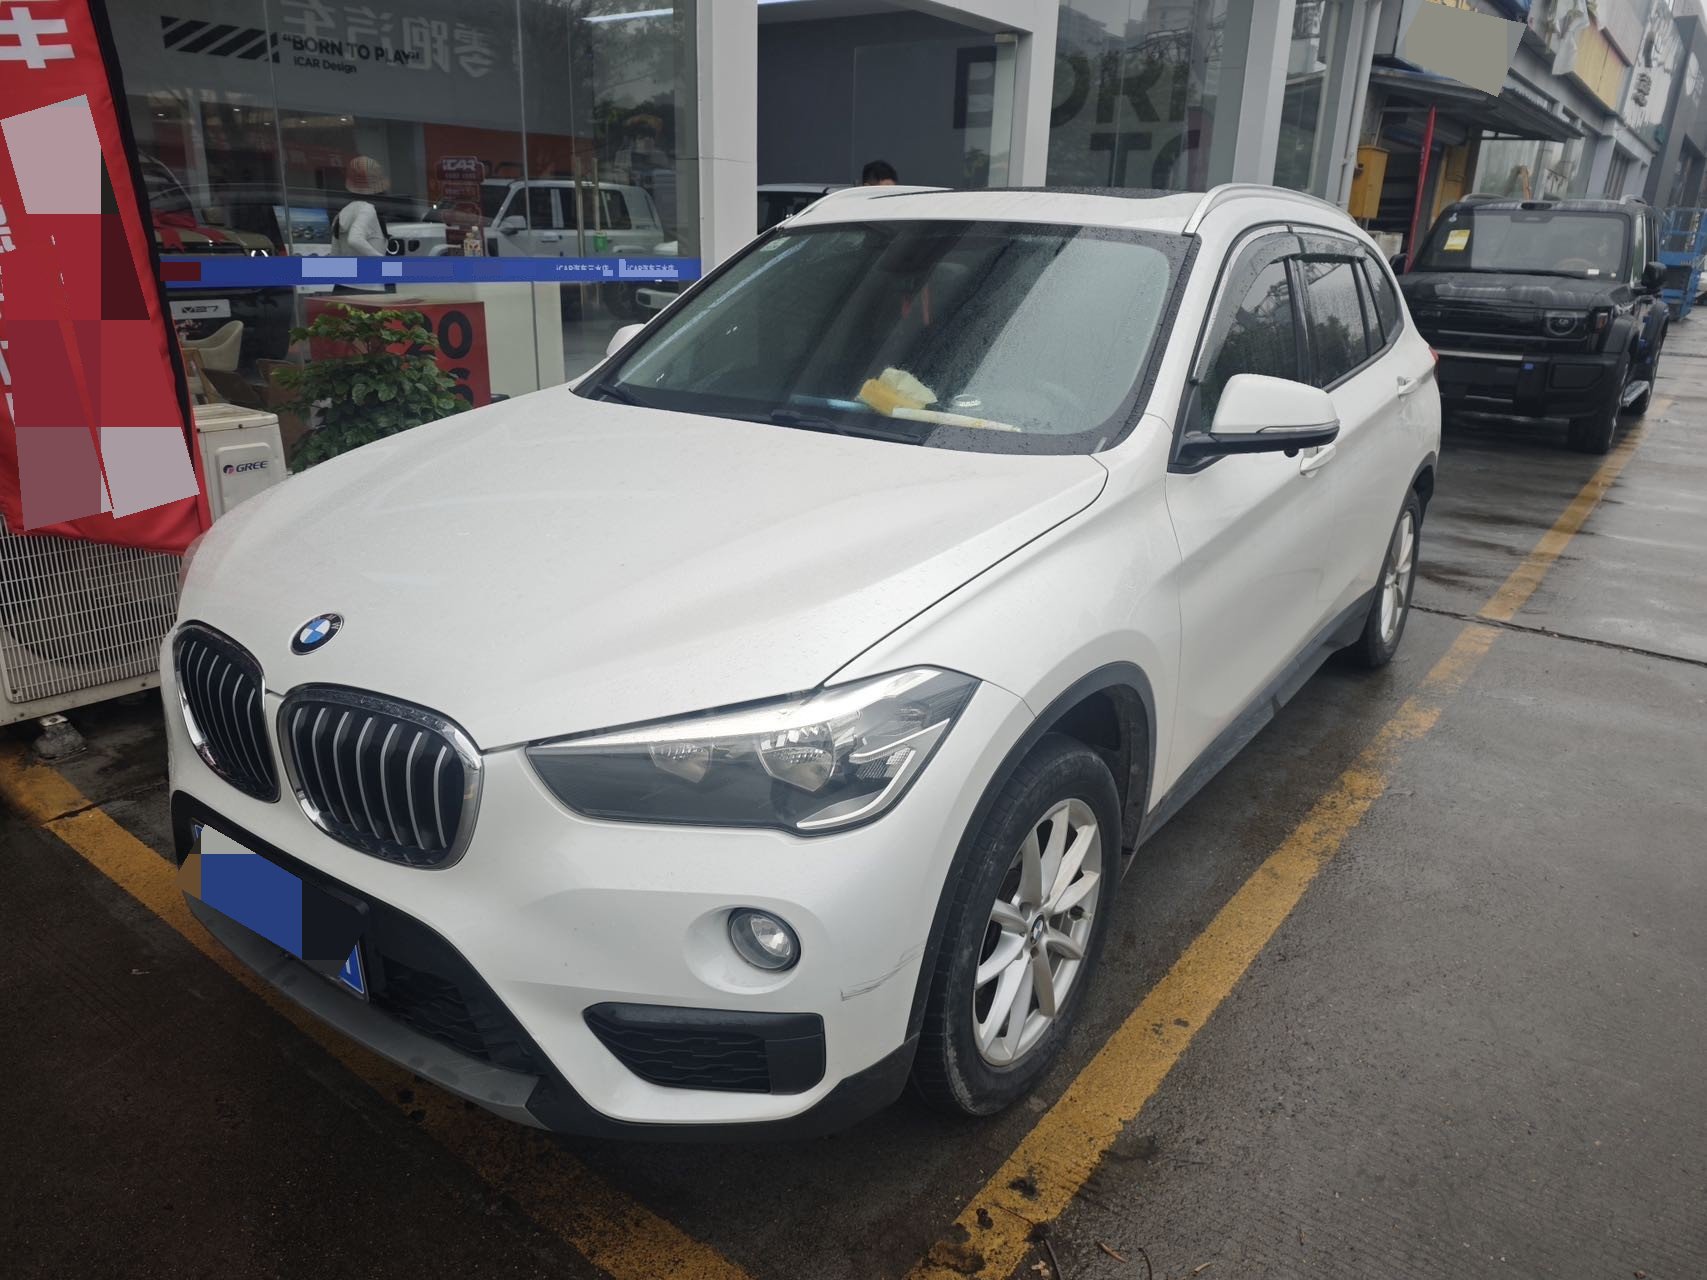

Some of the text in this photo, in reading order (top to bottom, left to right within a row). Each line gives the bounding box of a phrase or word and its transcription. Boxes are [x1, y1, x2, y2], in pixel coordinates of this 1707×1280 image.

[345, 42, 371, 61] TO
[322, 59, 357, 74] Design
[236, 460, 269, 473] GREE
